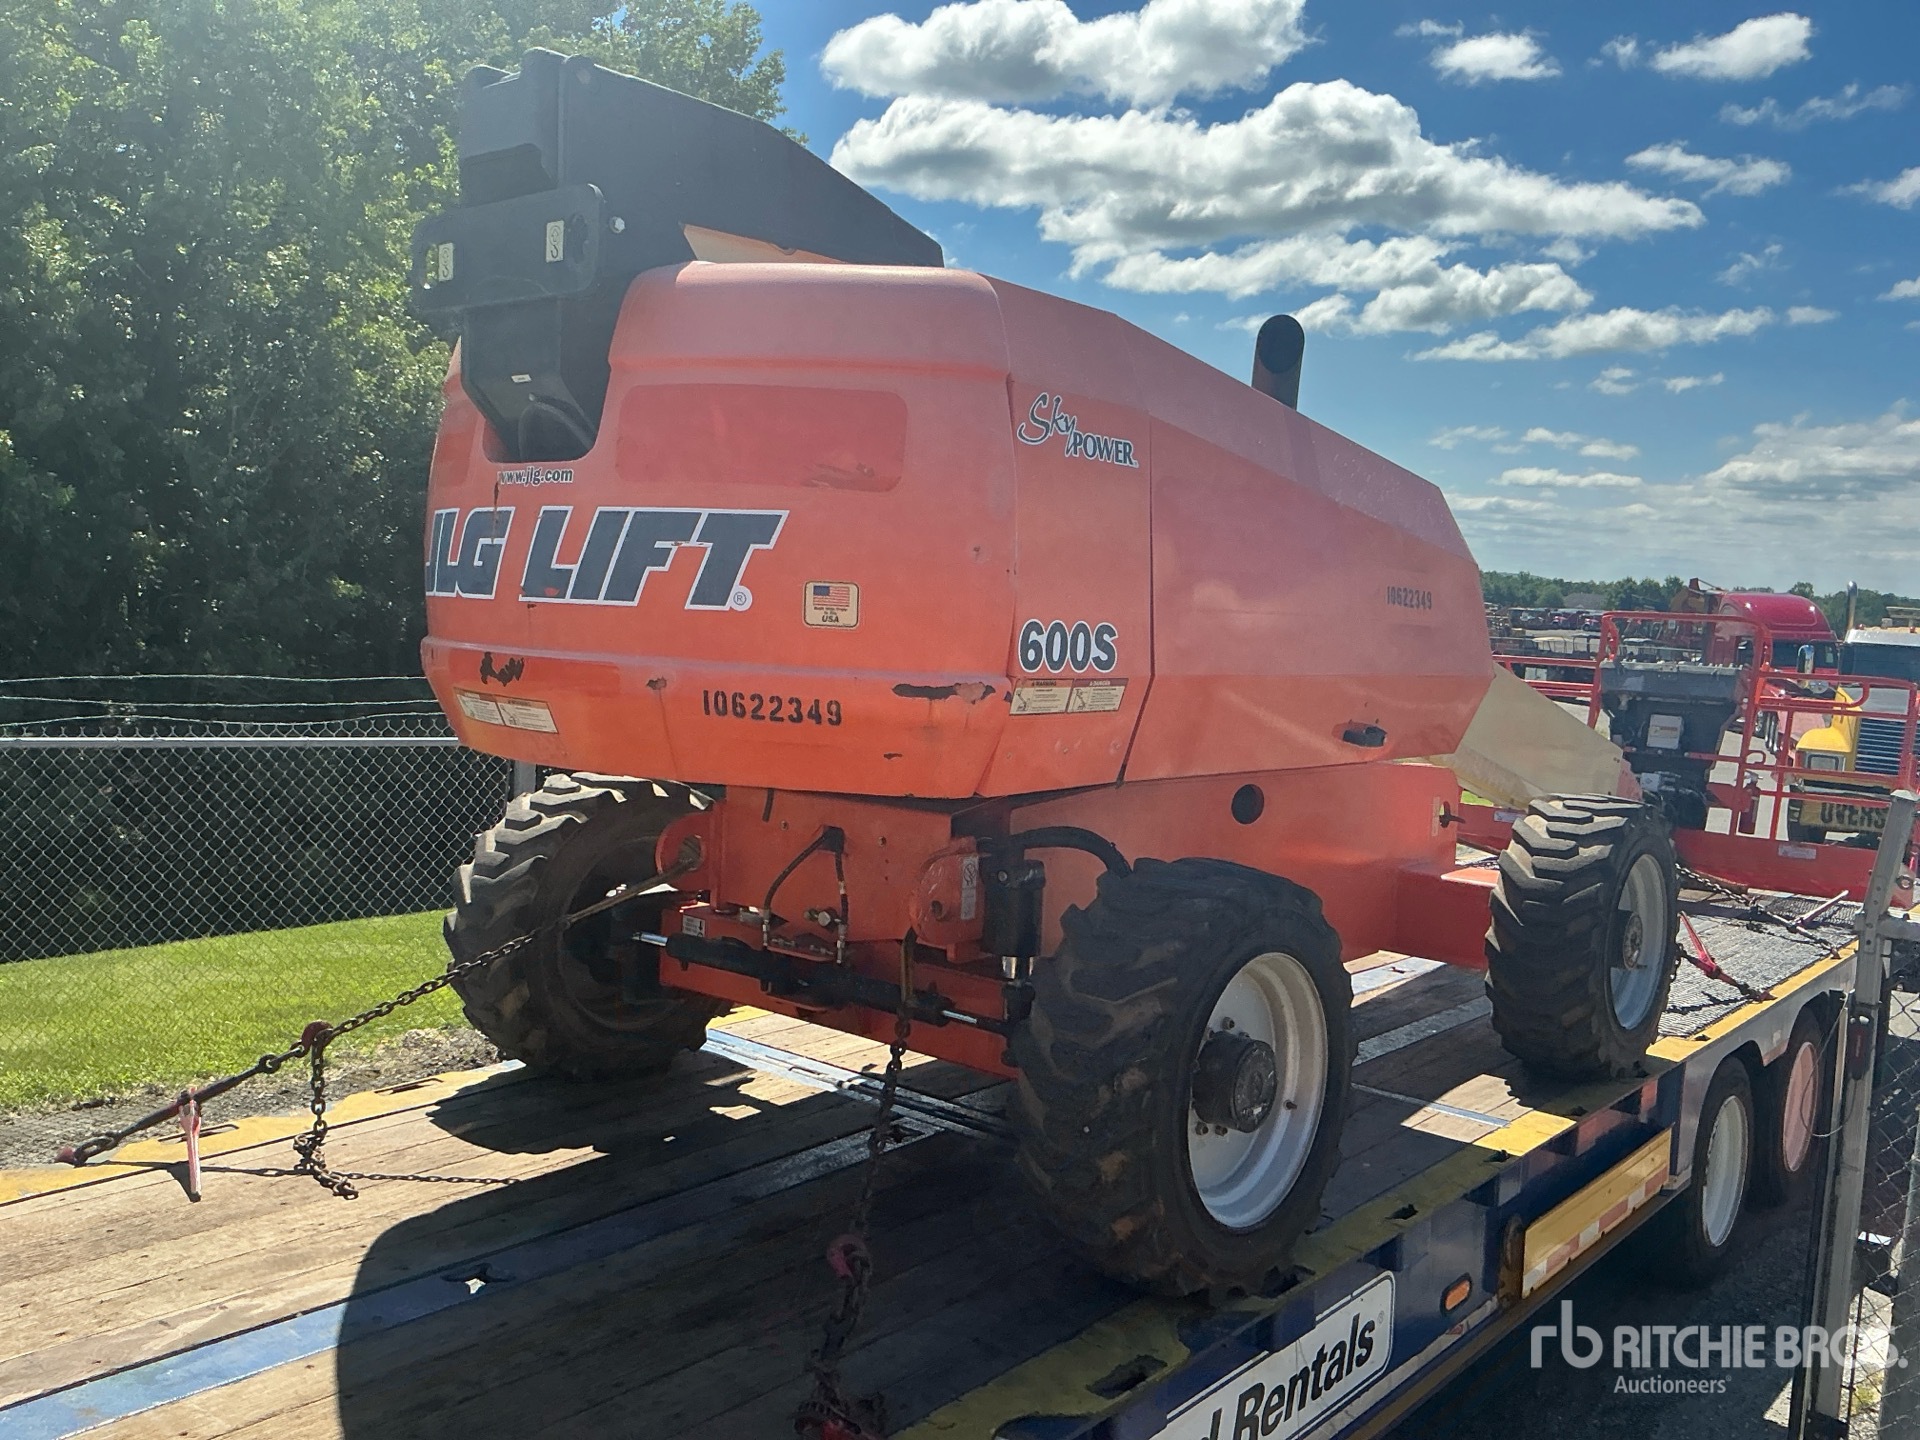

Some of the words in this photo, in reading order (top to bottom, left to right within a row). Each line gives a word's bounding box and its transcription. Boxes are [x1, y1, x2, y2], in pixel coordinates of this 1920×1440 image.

[1017, 391, 1077, 457] Sky
[1070, 430, 1138, 468] POWER
[498, 466, 574, 488] www.jlg.com
[425, 506, 516, 600] JLG
[1386, 586, 1433, 611] 10622349
[821, 615, 839, 623] USA
[1019, 619, 1118, 673] 600S
[702, 689, 843, 727] 10622349
